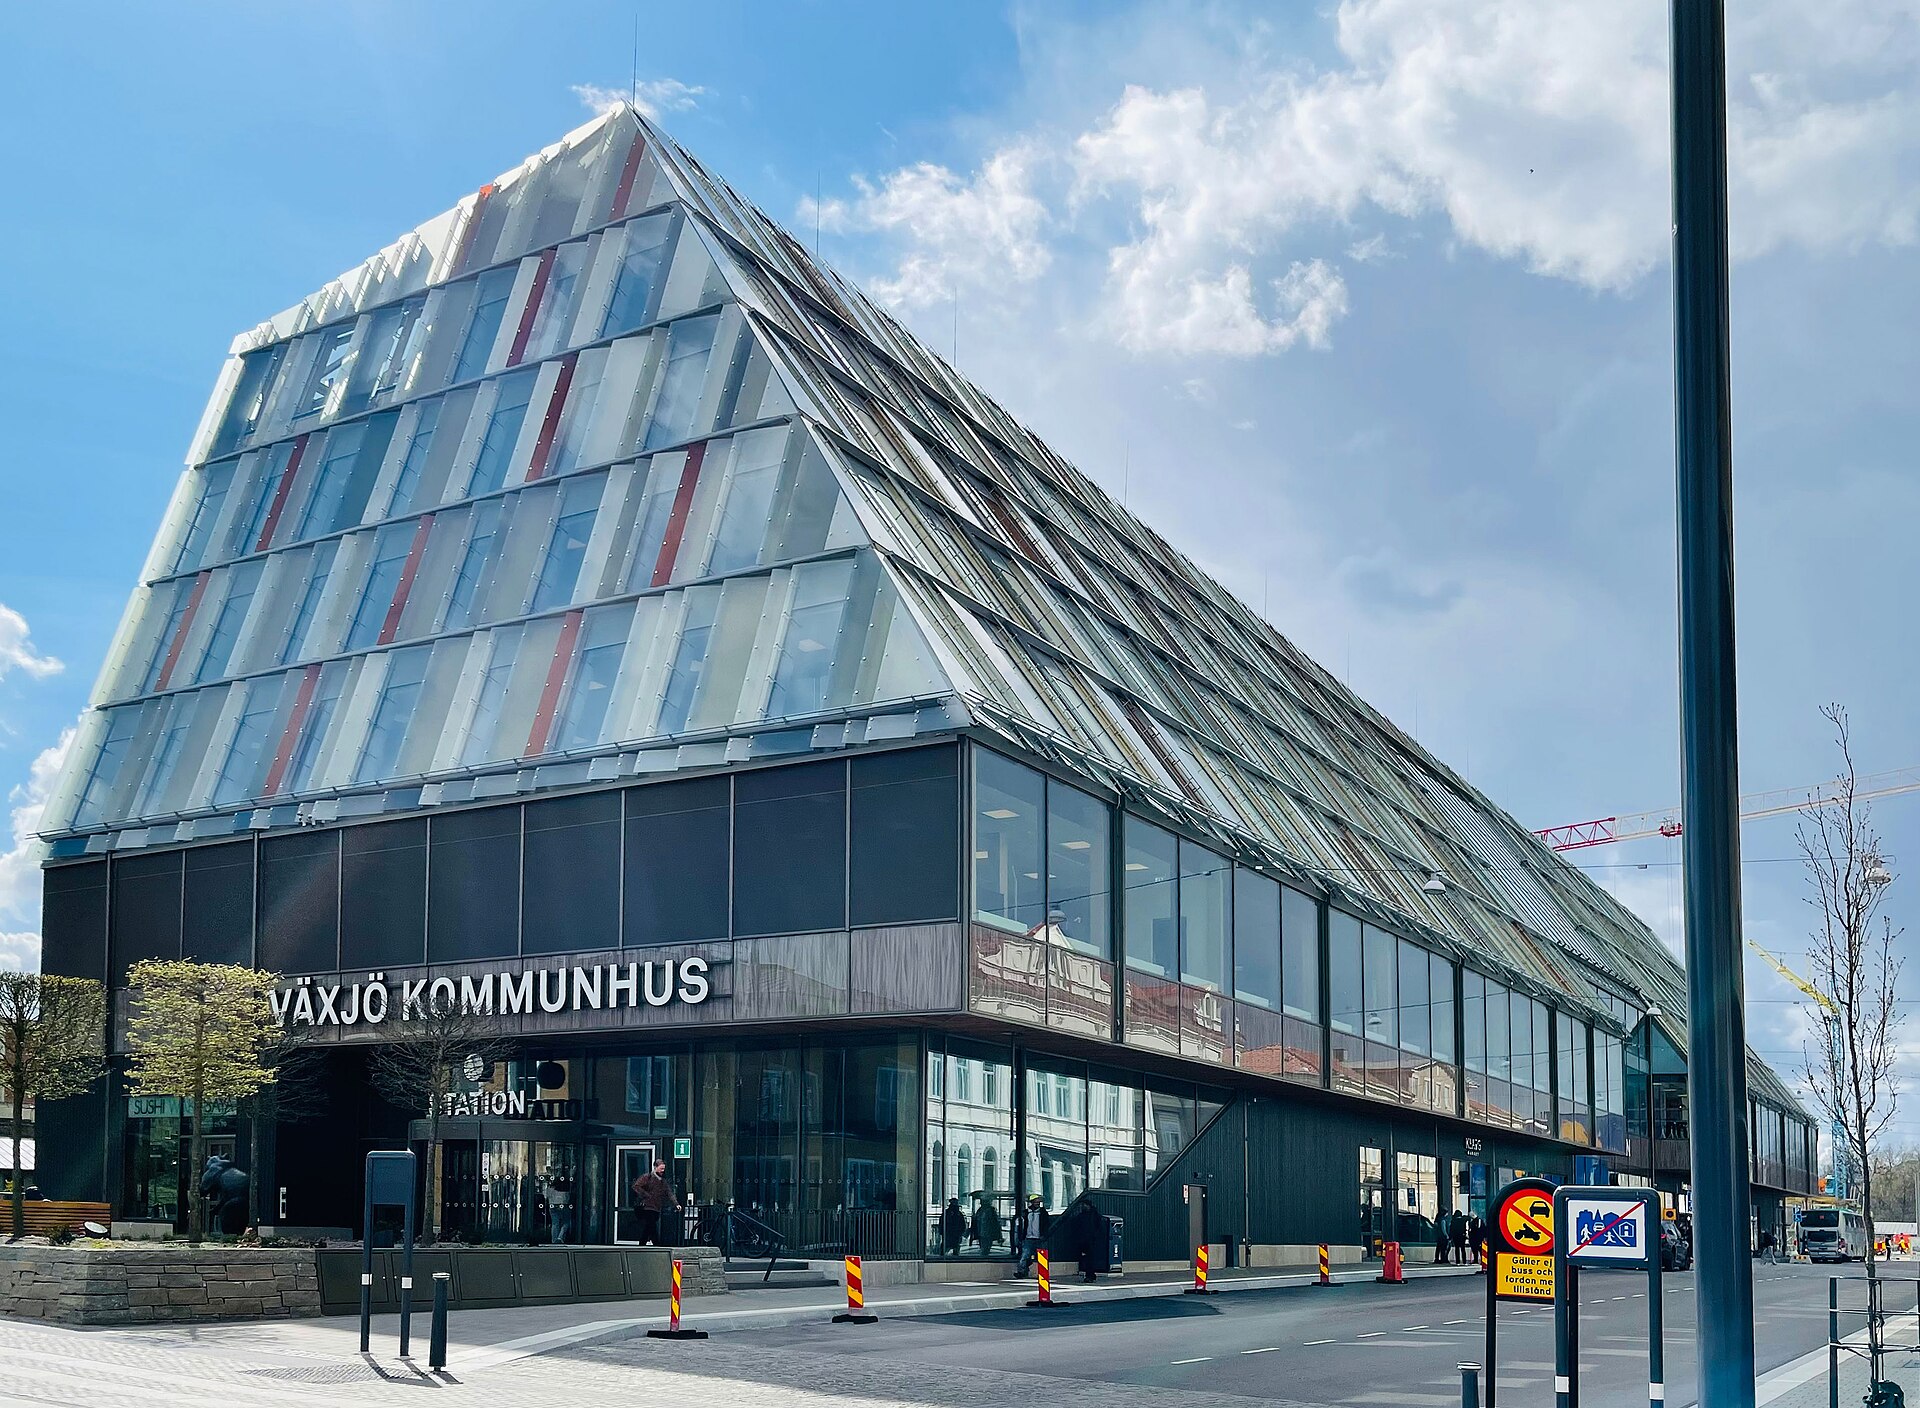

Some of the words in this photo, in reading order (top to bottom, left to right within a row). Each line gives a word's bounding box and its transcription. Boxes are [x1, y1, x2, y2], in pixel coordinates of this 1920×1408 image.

[269, 972, 387, 1027] VÄXJÖ
[402, 957, 709, 1021] KOMMUNHUS
[134, 1099, 165, 1114] SUSHI
[1512, 1256, 1540, 1266] Gäller
[1543, 1258, 1552, 1268] ej
[1511, 1266, 1533, 1275] buss
[1536, 1268, 1553, 1276] och
[1505, 1275, 1536, 1285] fordon
[1512, 1285, 1552, 1296] tillstånd
